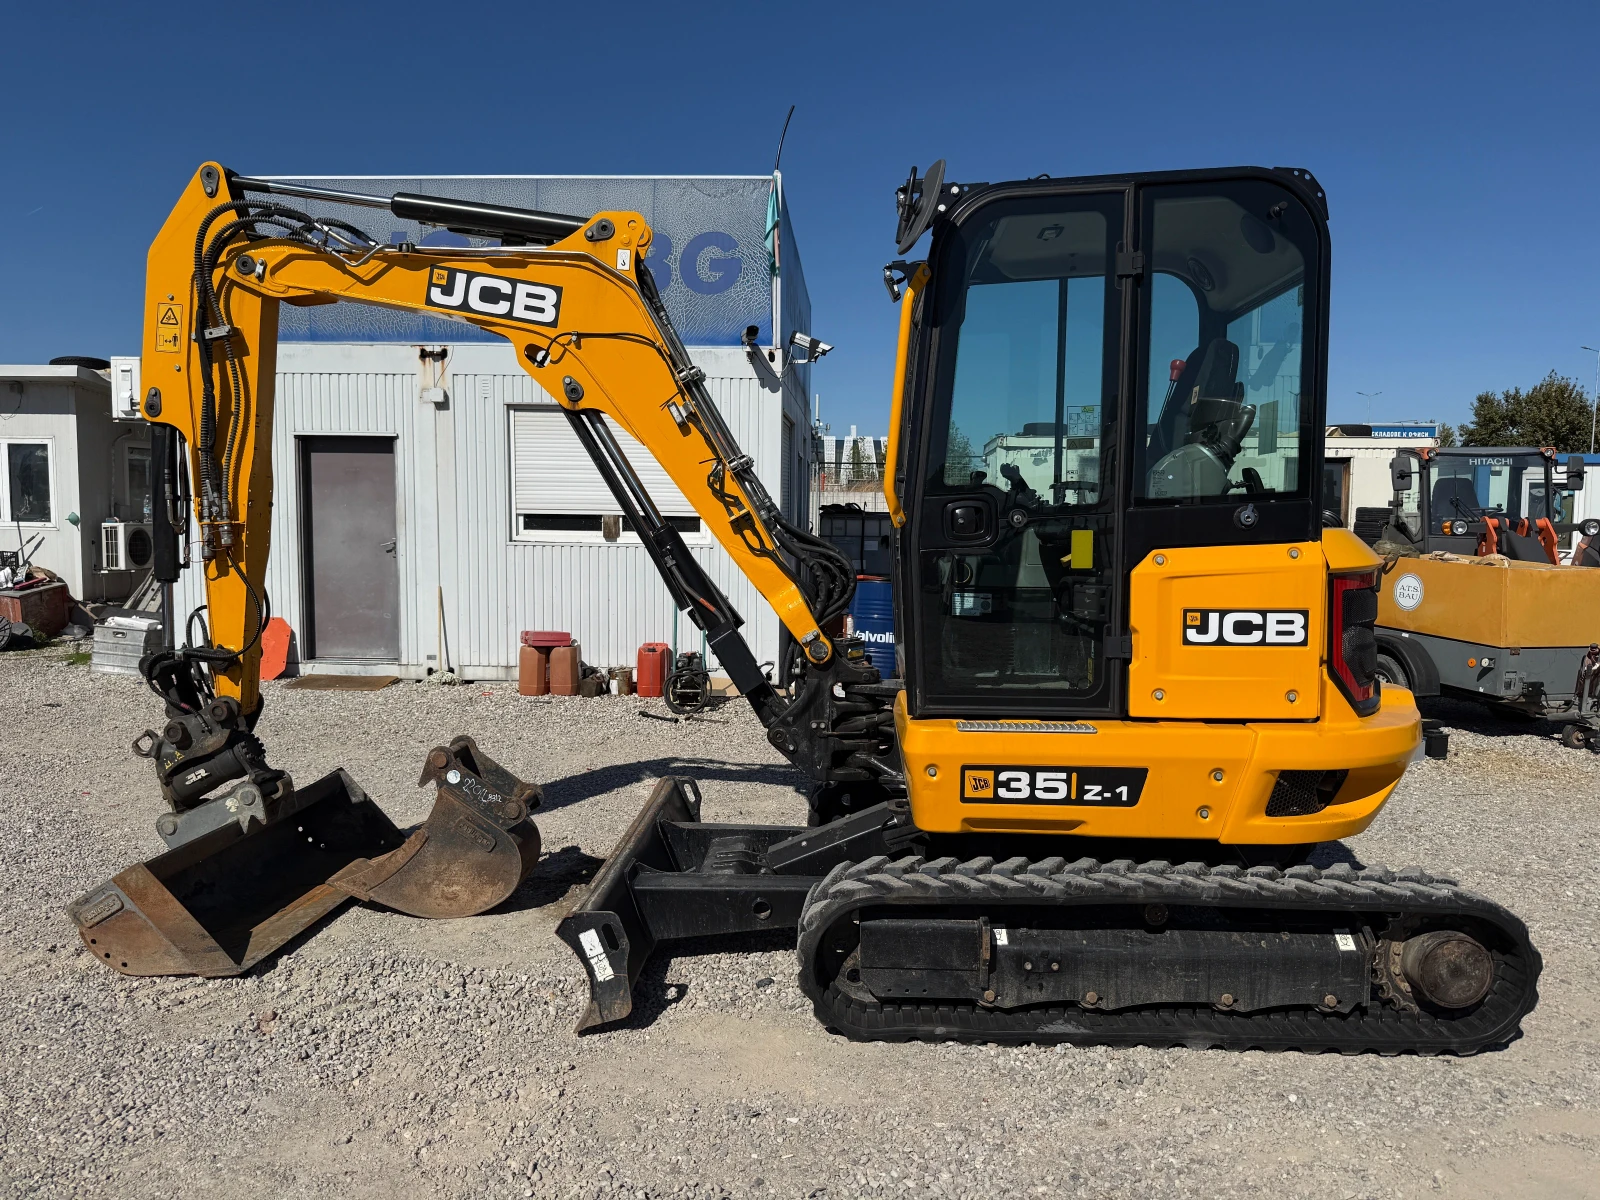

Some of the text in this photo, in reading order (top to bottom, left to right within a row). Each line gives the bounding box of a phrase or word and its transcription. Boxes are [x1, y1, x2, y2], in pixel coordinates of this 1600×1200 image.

[430, 272, 558, 323] JCB
[1398, 592, 1418, 600] BAU
[1186, 612, 1305, 643] JCB
[968, 774, 991, 793] JCB
[997, 771, 1068, 800] 35
